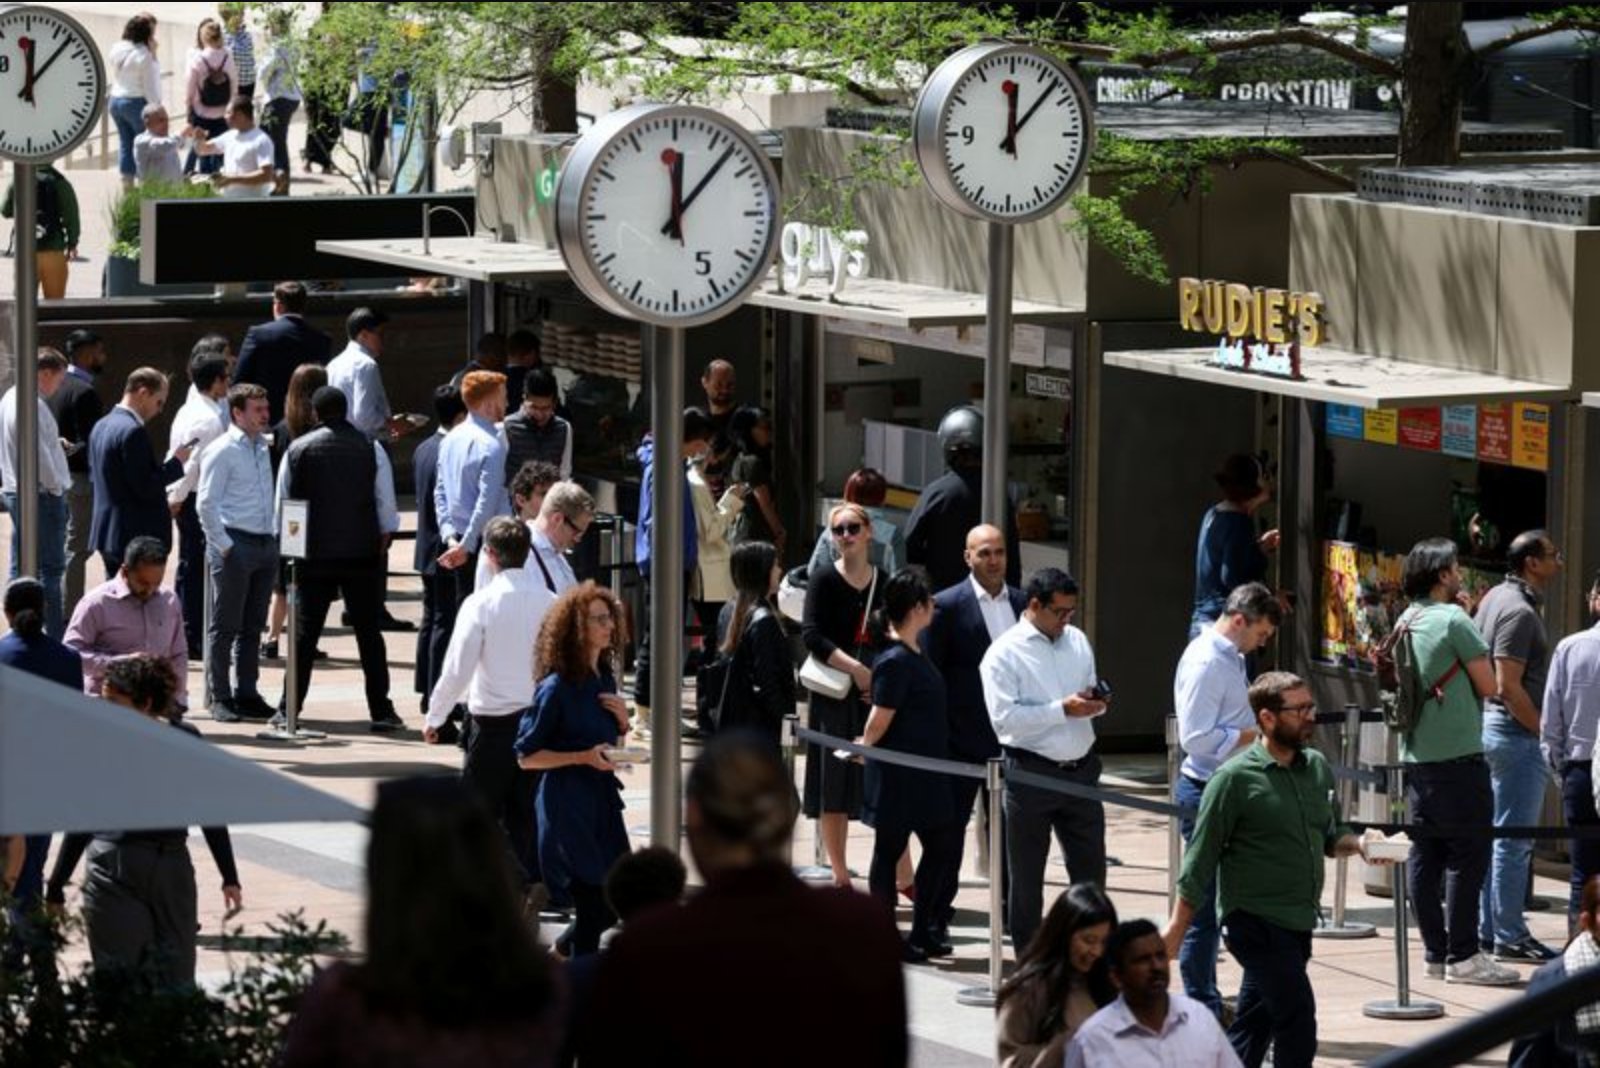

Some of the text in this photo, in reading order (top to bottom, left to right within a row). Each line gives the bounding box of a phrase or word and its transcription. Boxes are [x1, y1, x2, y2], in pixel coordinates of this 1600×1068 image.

[962, 125, 975, 146] 9
[695, 251, 712, 275] 5
[1179, 277, 1325, 347] RUDIE'S
